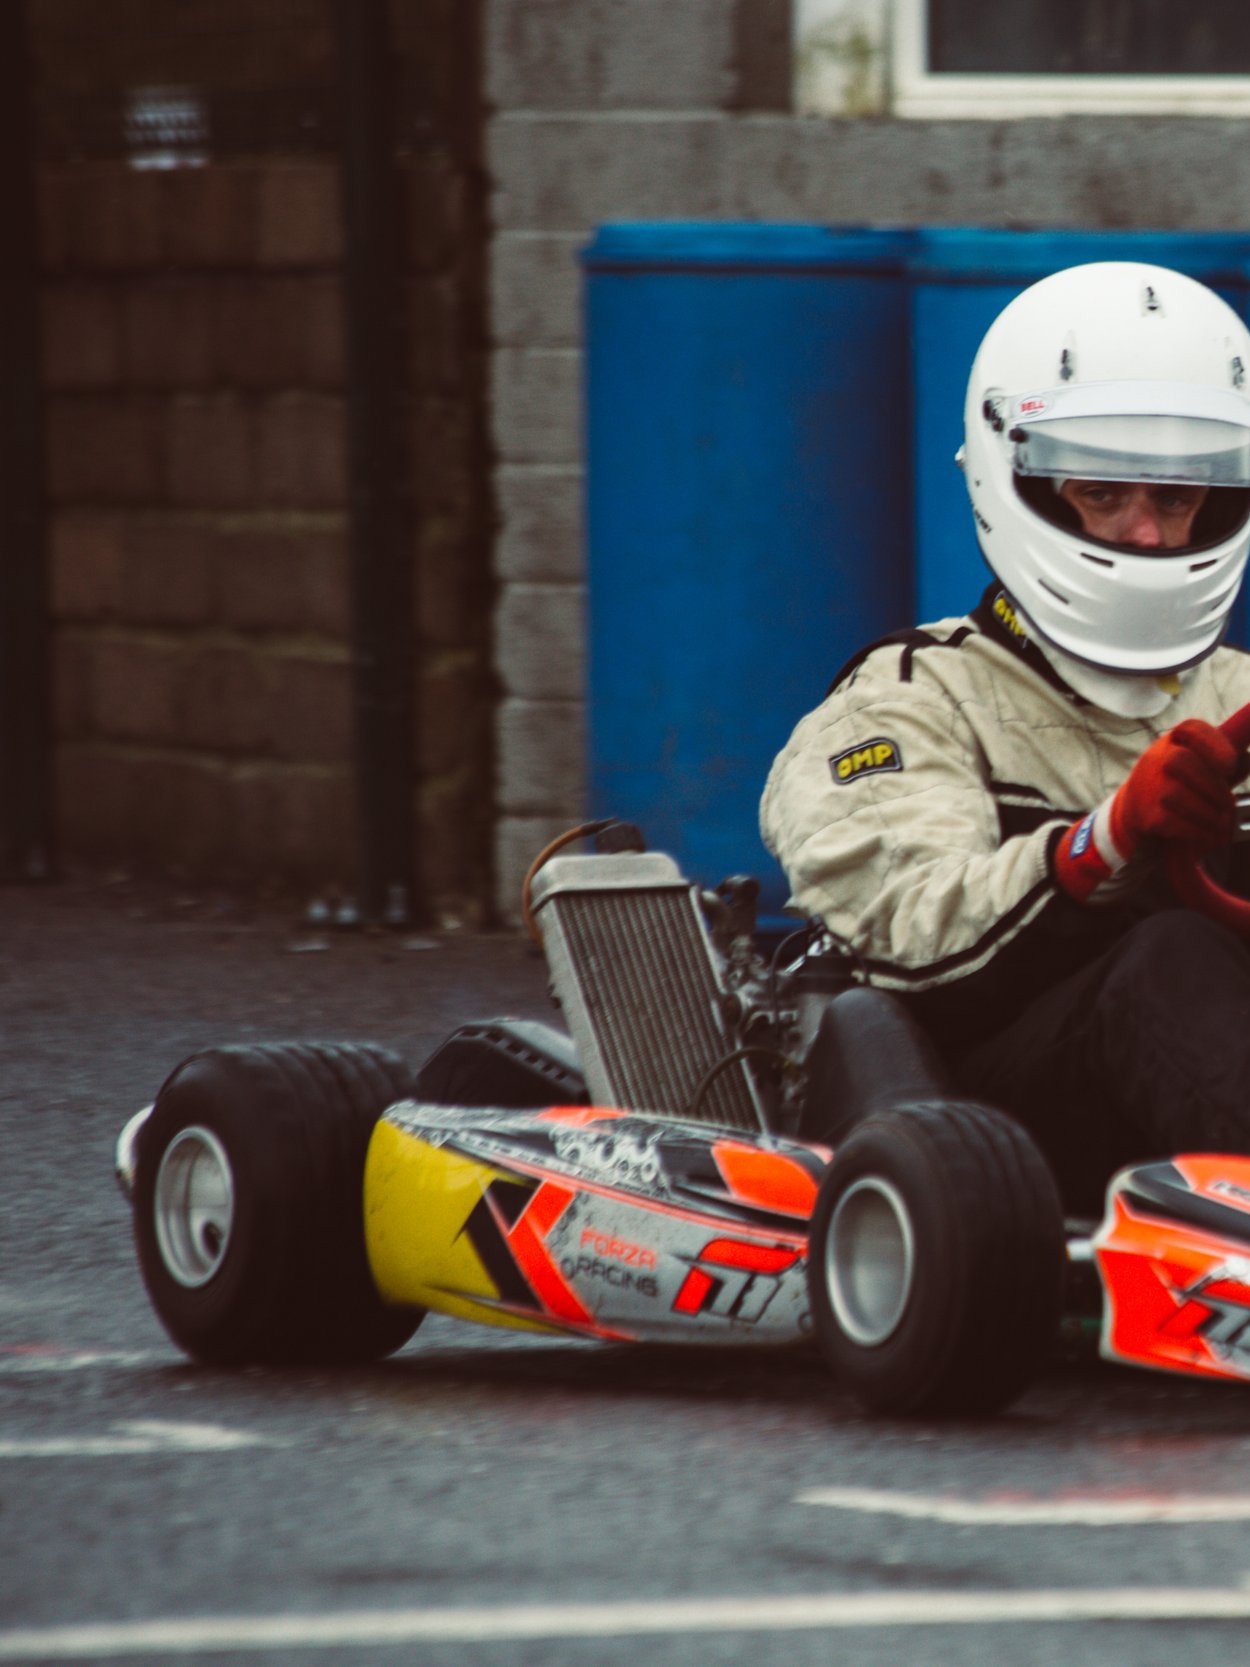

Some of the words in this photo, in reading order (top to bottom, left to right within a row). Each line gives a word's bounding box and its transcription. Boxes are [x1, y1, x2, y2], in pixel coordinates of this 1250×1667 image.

[837, 743, 893, 778] OMP
[580, 1228, 657, 1270] FORZA
[576, 1256, 658, 1297] RACING
